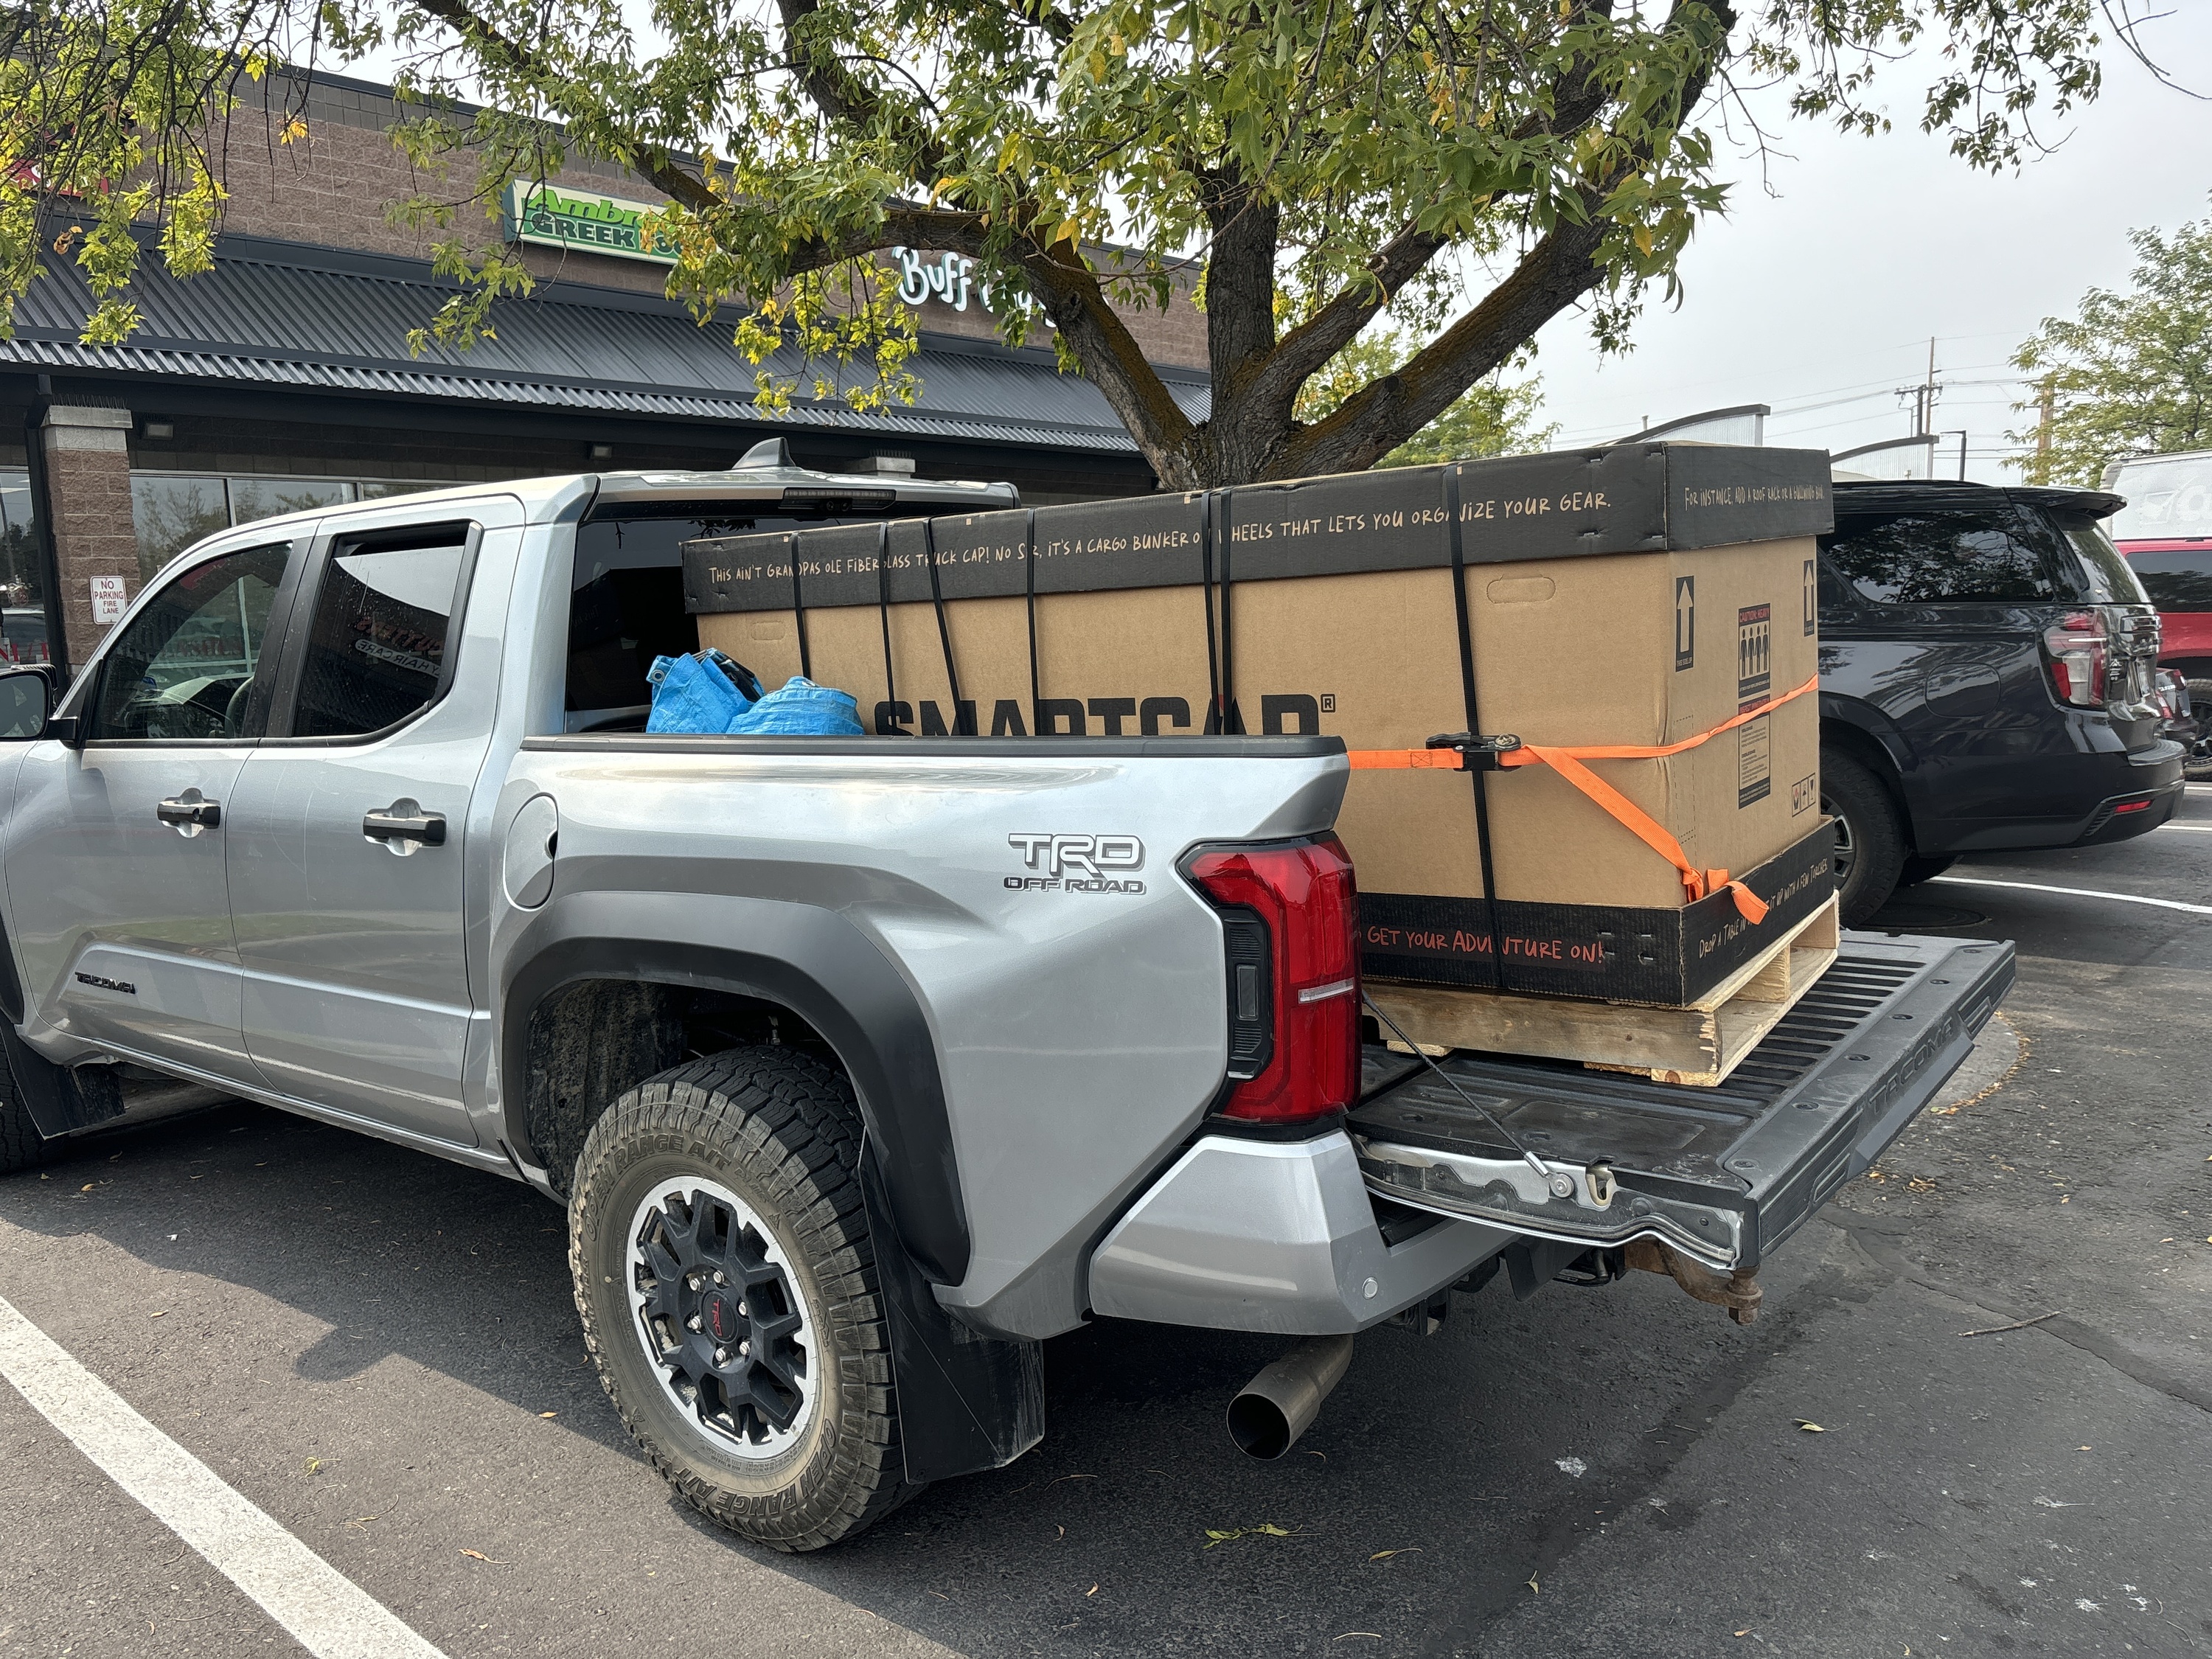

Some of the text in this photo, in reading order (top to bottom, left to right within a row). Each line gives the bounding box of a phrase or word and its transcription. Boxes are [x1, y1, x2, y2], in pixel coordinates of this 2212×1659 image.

[530, 211, 636, 249] GREEK
[891, 246, 973, 312] Buff
[1735, 486, 1745, 504] ADD
[1747, 487, 1751, 502] A
[1753, 486, 1765, 504] ROOF
[1767, 484, 1781, 502] RACK
[1781, 487, 1788, 501] OR
[825, 559, 842, 574] OLE
[847, 554, 911, 574] FIBERLASS
[963, 546, 990, 564] CAP!
[995, 546, 1011, 561] NO
[1017, 542, 1043, 560] SR,
[1075, 537, 1082, 554] A
[1087, 536, 1127, 554] CARGO
[1133, 530, 1189, 551] BUNKER
[1218, 523, 1273, 545] HEELS
[1279, 518, 1322, 537] THAT
[1328, 514, 1366, 533] LETS
[1372, 509, 1403, 531] YOU
[1503, 496, 1551, 519] YOUR
[1559, 491, 1611, 512] GEAR.
[94, 591, 124, 600] PARKING
[100, 580, 114, 590] NO
[1009, 833, 1146, 880] TRD
[1004, 877, 1147, 894] OFF ROAD
[1366, 925, 1604, 964] GET YOUR ADVNTURE ON!
[1700, 933, 1717, 959] DROP
[1869, 1016, 1952, 1113] TACOMA
[585, 1166, 616, 1242] OPEN
[613, 1133, 685, 1175] RANGE
[687, 1140, 732, 1171] A/T
[712, 1298, 723, 1337] TRD
[799, 1418, 837, 1500] OPEN
[673, 1467, 718, 1500] A/T
[715, 1483, 798, 1517] RANGE
